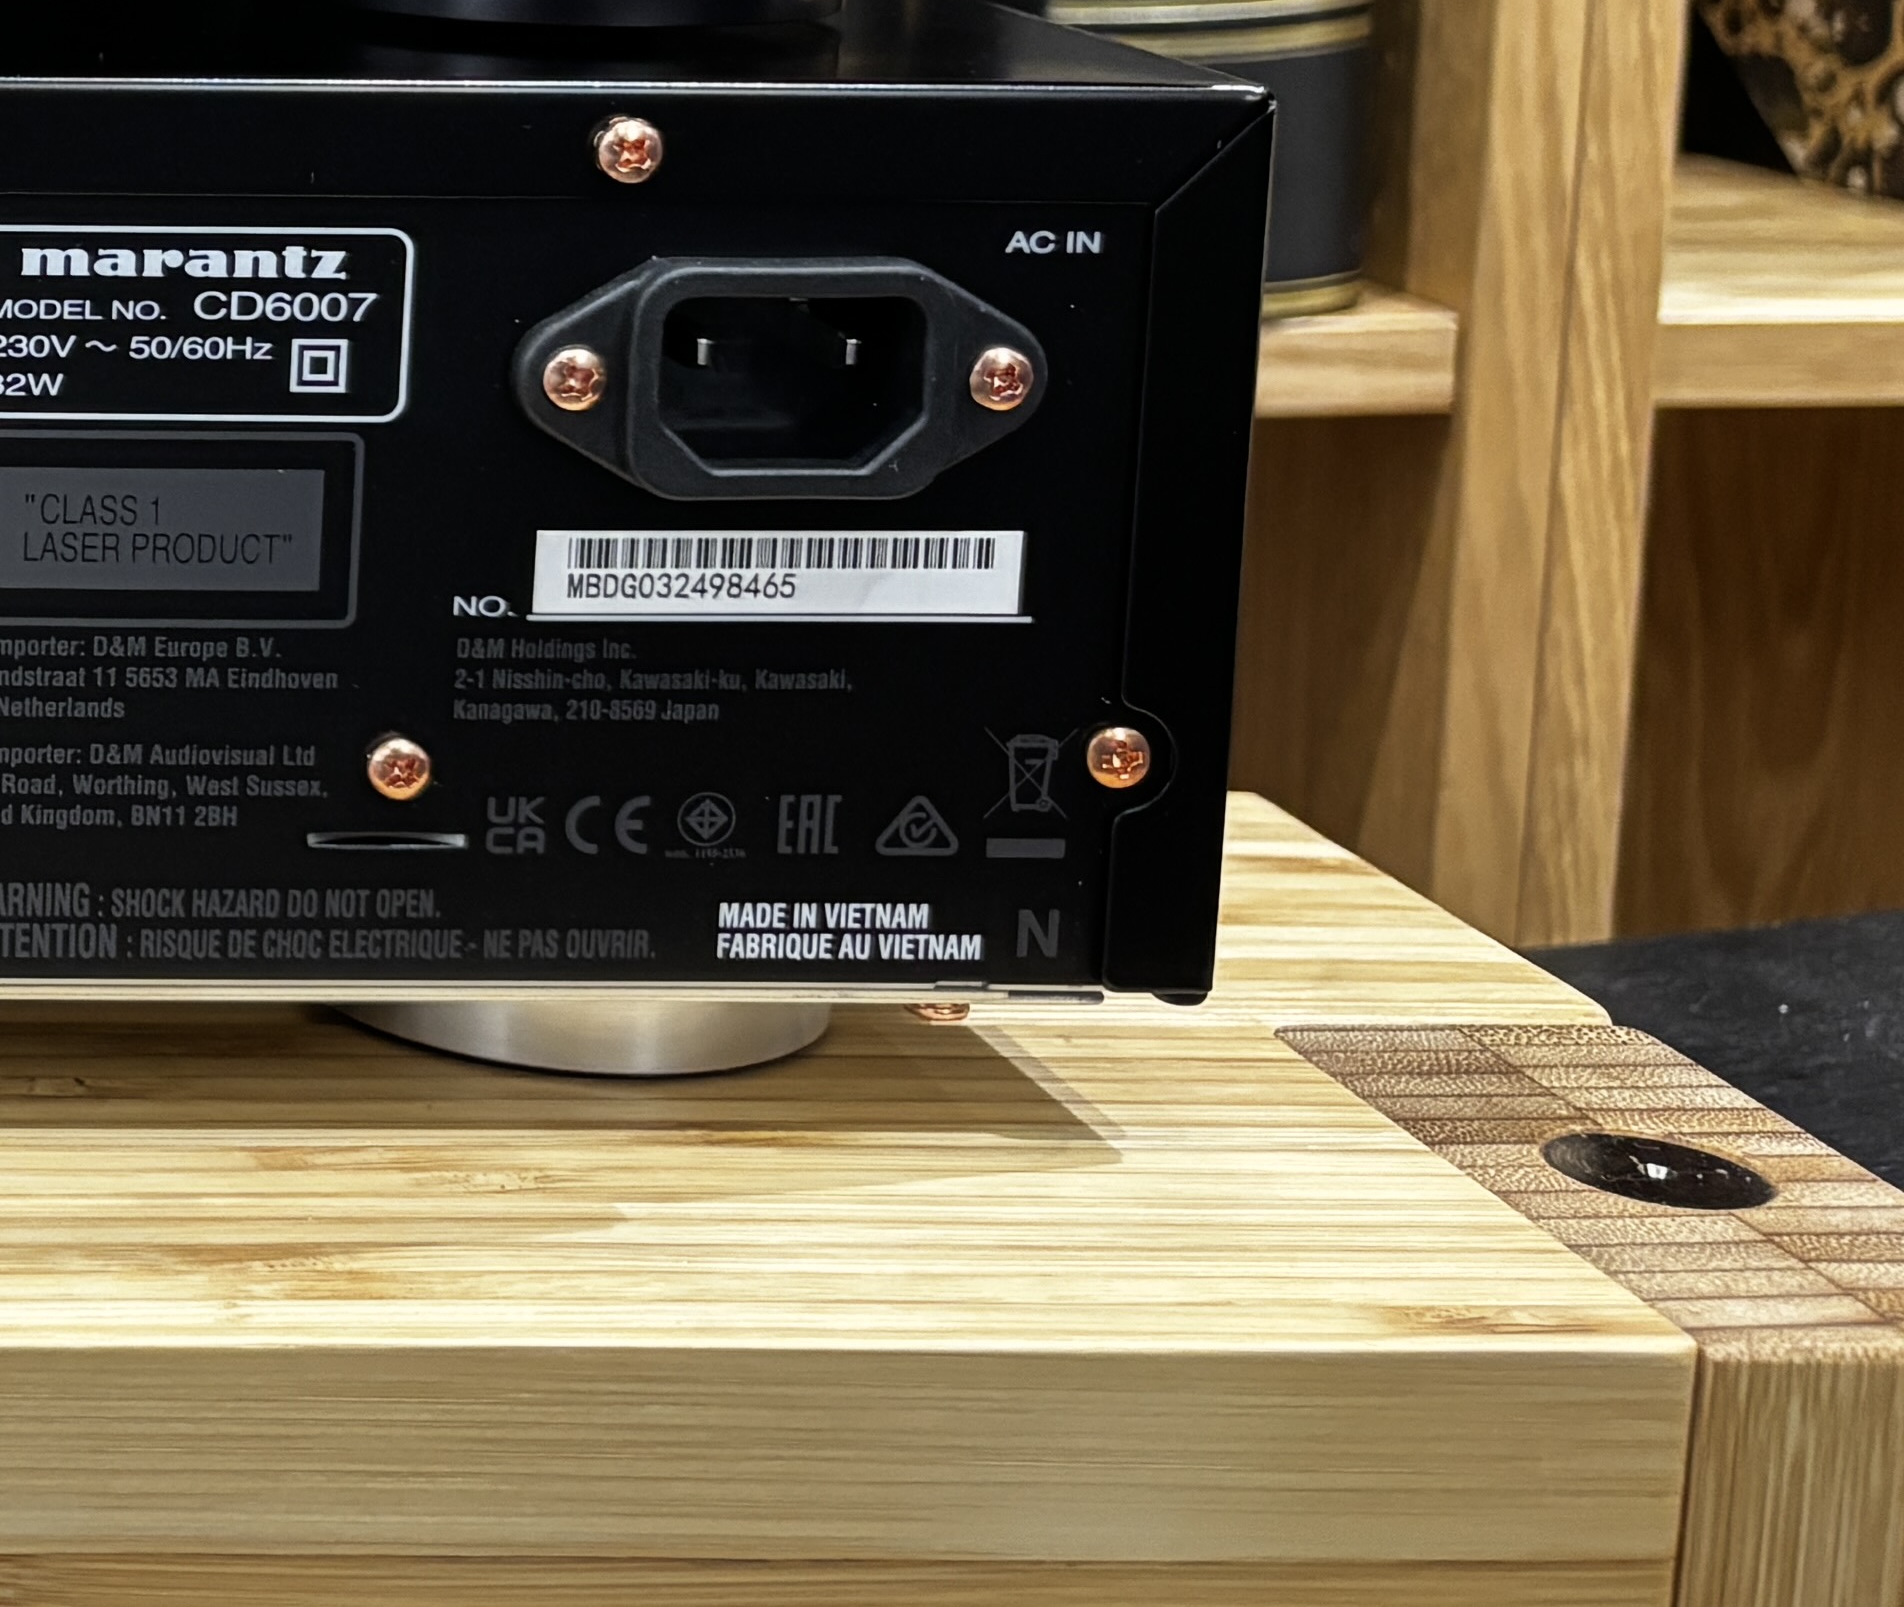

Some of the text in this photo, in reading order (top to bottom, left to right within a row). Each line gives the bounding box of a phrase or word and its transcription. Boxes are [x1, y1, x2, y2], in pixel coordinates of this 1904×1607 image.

[1005, 231, 1101, 253] AC IN
[21, 246, 346, 279] marantz
[112, 300, 166, 320] NO.
[194, 291, 378, 321] CD6007
[129, 336, 272, 359] 50/60Hz
[26, 494, 158, 526] "CLASS 1
[24, 532, 292, 564] LASER PRODUCT"
[567, 573, 796, 599] MBDG032498465
[453, 596, 515, 617] NO.
[94, 636, 146, 656] D&M
[155, 637, 227, 661] Europe
[236, 637, 280, 657] B.V.
[93, 667, 116, 687] 11
[126, 667, 177, 688] 5653
[186, 668, 219, 687] MA
[228, 668, 337, 688] Eindhoven
[90, 744, 142, 764] D&M
[150, 744, 274, 765] Audiovisual
[283, 745, 315, 766] Ltd
[2, 773, 63, 797] Road,
[73, 774, 176, 800] Worthing,
[186, 775, 238, 795] West
[21, 804, 122, 829] Kingdom,
[131, 805, 184, 826] BN11
[195, 806, 237, 826] 2BH
[719, 903, 929, 929] MADE IN VIETNAM
[717, 933, 981, 960] FABRIQUE AU VIETNAM
